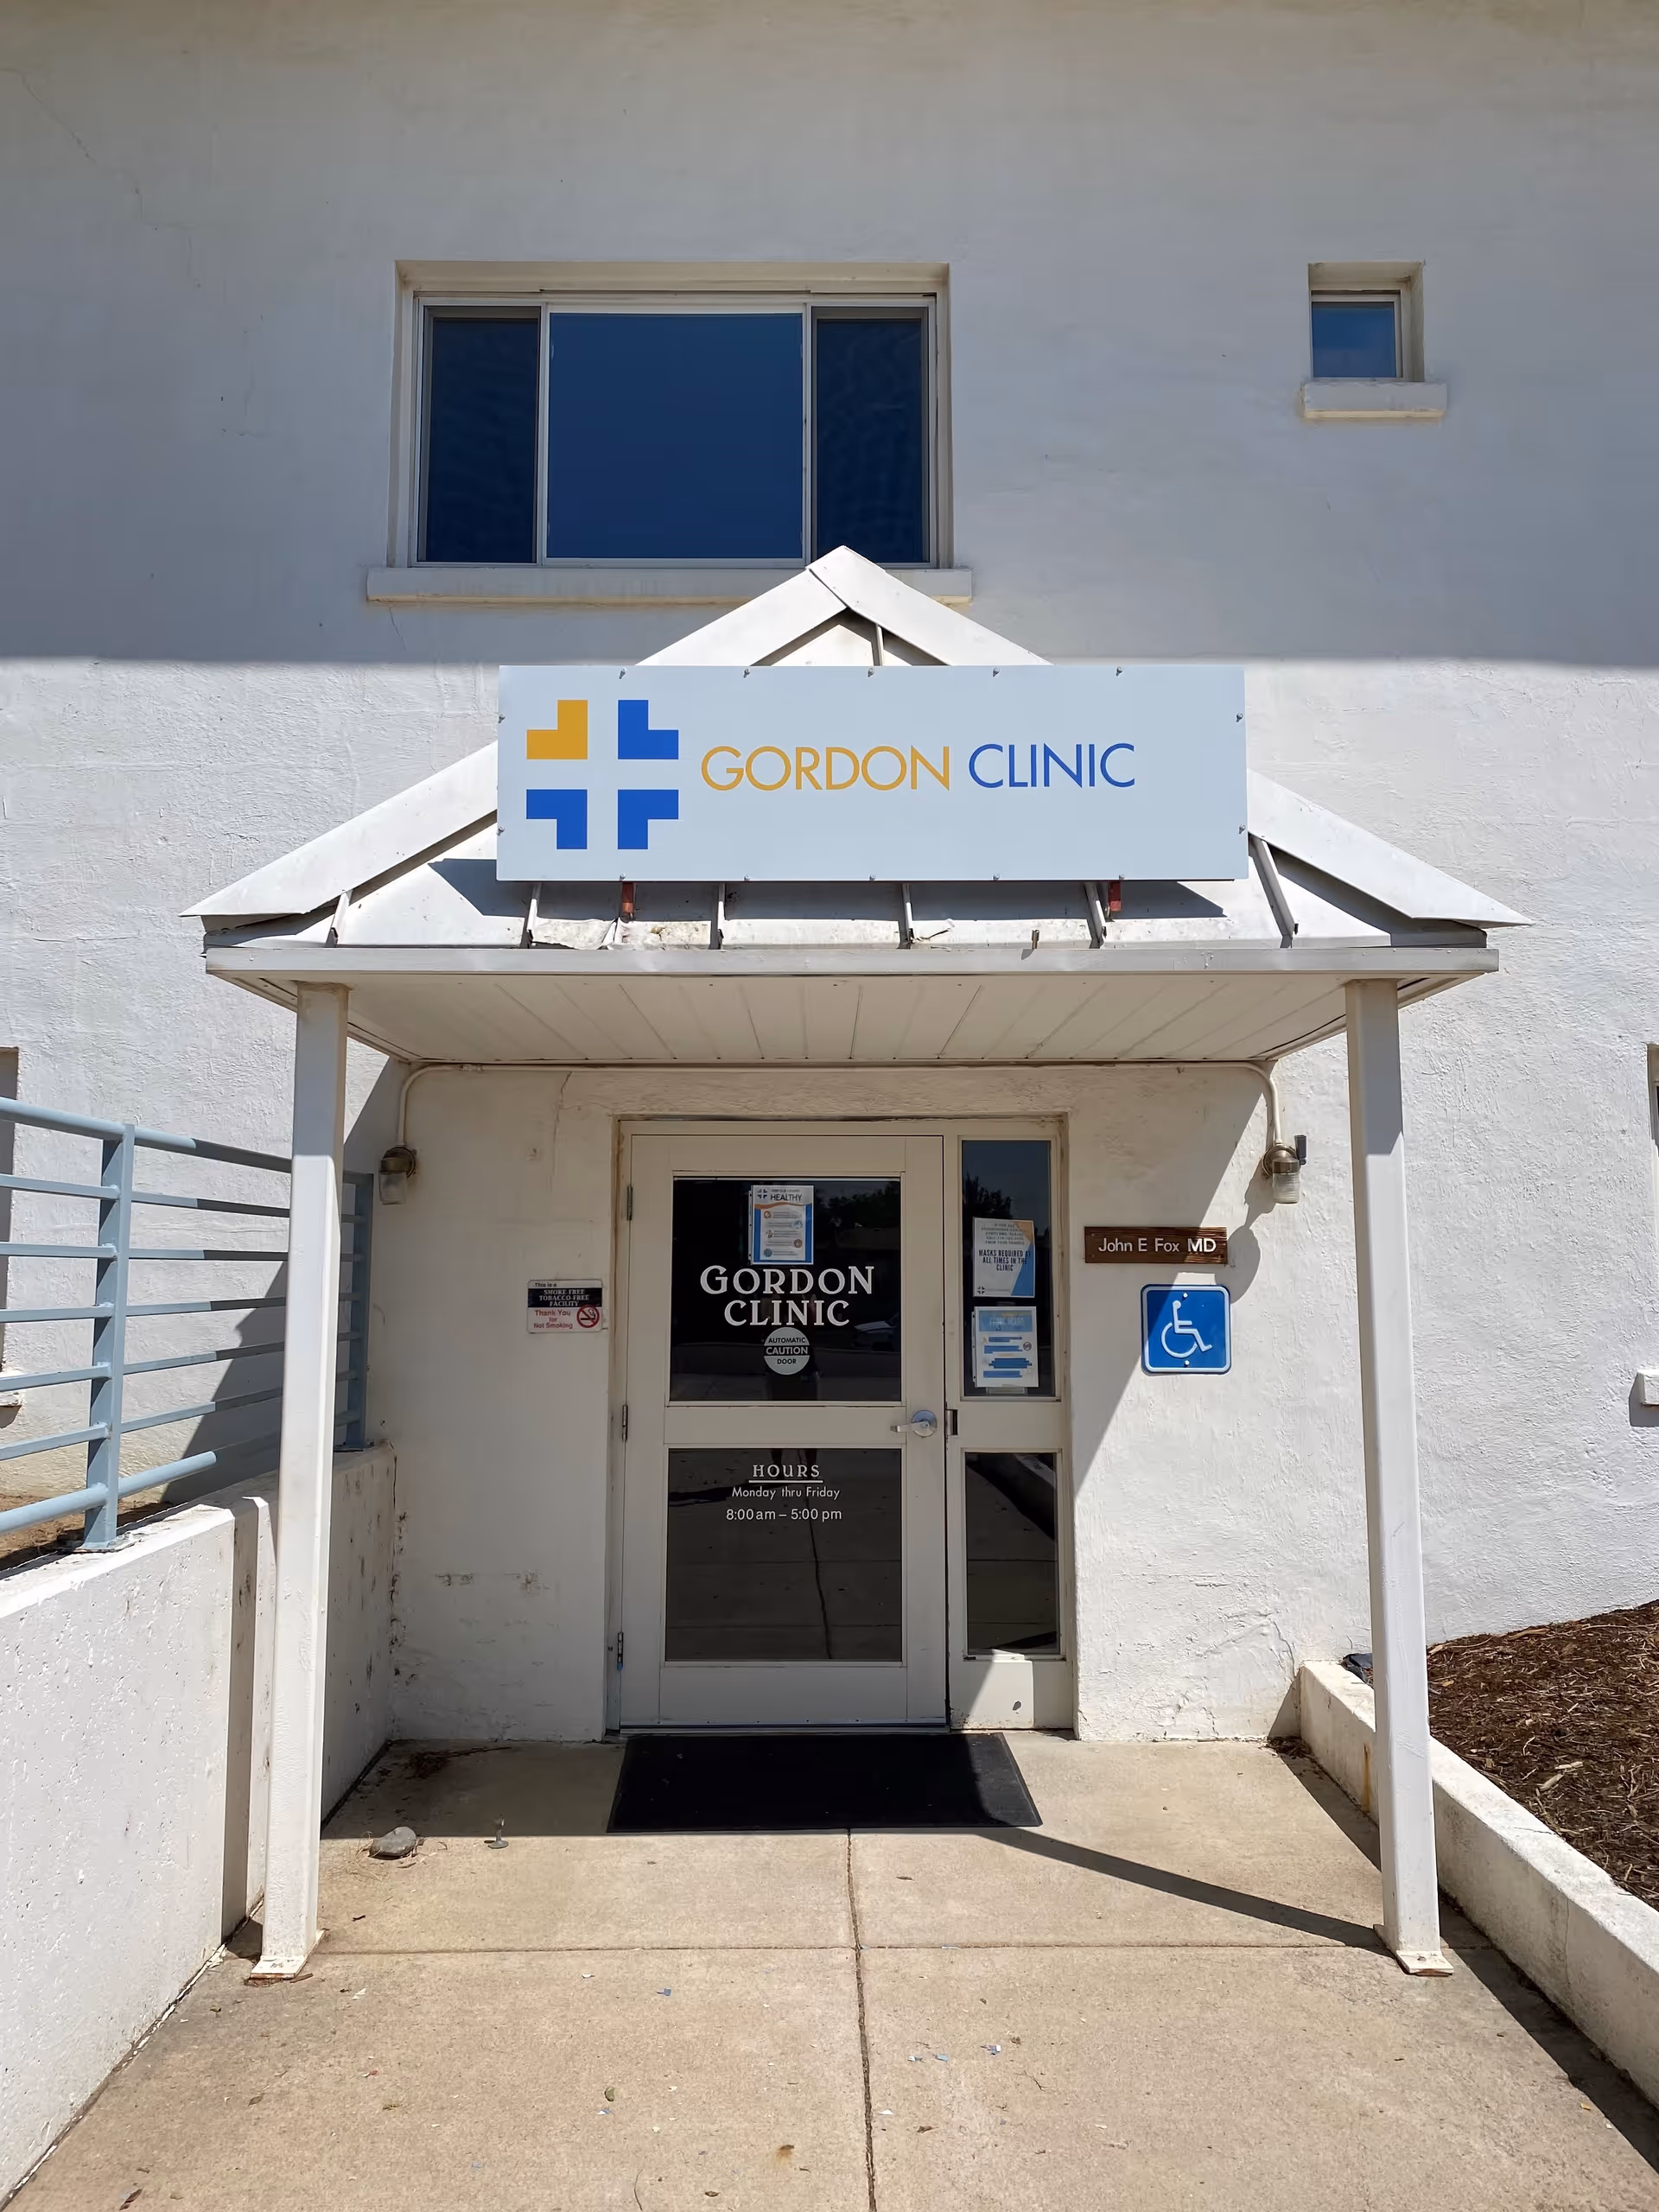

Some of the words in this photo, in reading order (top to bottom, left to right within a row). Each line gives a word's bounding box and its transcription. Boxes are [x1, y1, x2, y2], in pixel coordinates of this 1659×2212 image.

[701, 746, 950, 791] GORDON
[969, 743, 1135, 788] CLINIC
[1098, 1237, 1133, 1253] John
[1138, 1237, 1147, 1252] E
[1154, 1237, 1180, 1252] Fox
[1187, 1237, 1217, 1253] MD
[700, 1265, 874, 1295] GORDON
[724, 1300, 849, 1326] CLINIC
[766, 1346, 809, 1356] CAUTION
[753, 1464, 820, 1478] HOURS
[731, 1486, 776, 1500] Monday
[781, 1486, 802, 1497] thru
[806, 1486, 840, 1500] Friday
